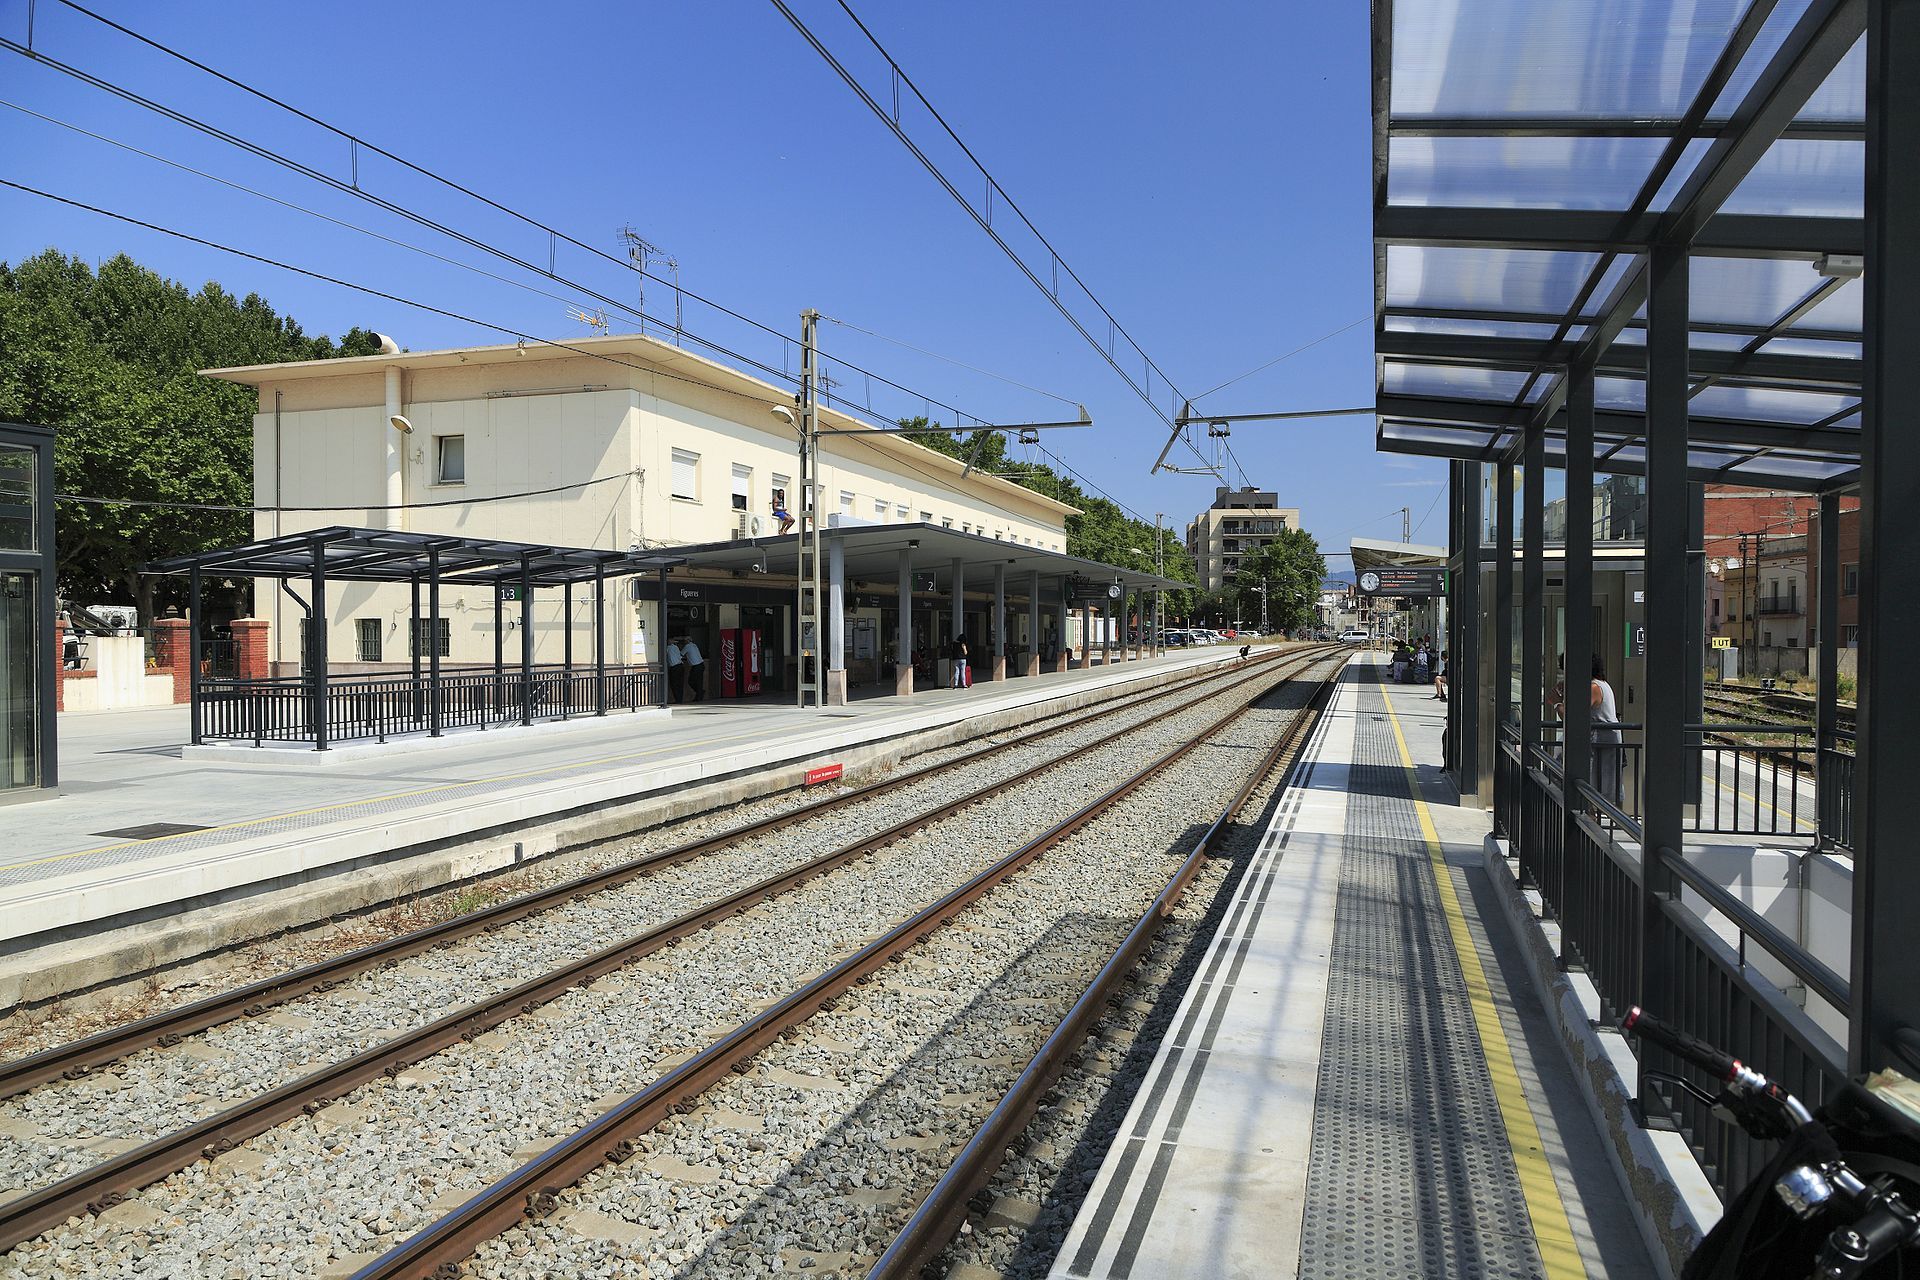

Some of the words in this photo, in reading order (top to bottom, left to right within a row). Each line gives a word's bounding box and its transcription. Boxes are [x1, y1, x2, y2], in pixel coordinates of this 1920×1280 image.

[928, 581, 934, 591] 2
[1440, 582, 1444, 591] 1
[680, 588, 699, 599] Figueres
